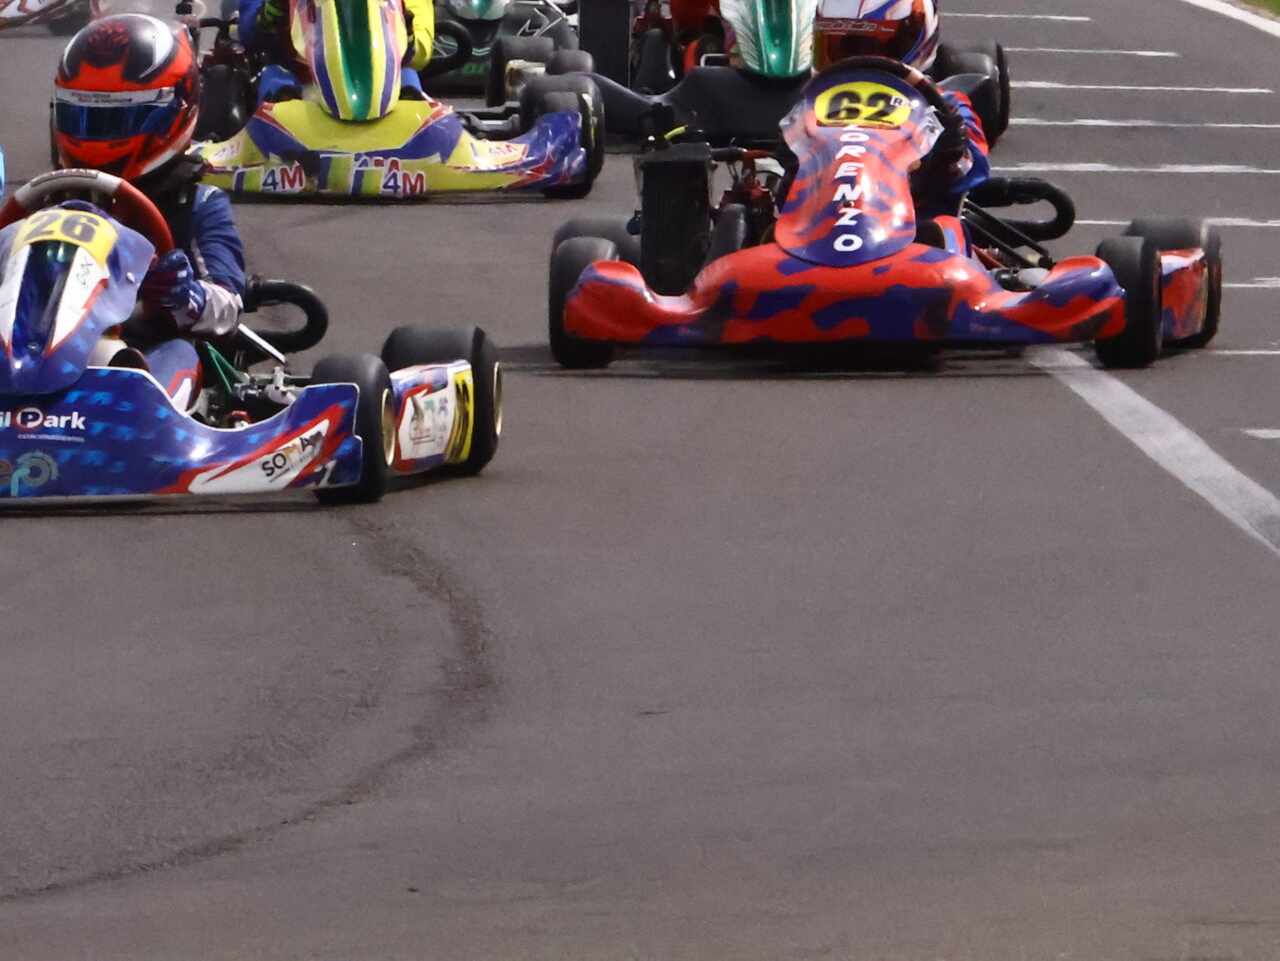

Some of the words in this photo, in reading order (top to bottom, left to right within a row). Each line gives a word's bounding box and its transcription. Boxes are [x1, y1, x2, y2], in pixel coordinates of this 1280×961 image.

[826, 91, 894, 125] 62
[261, 164, 304, 190] 4M
[381, 169, 426, 194] 4M
[23, 211, 101, 244] 26
[15, 407, 87, 431] Park
[261, 435, 316, 477] SOMA
